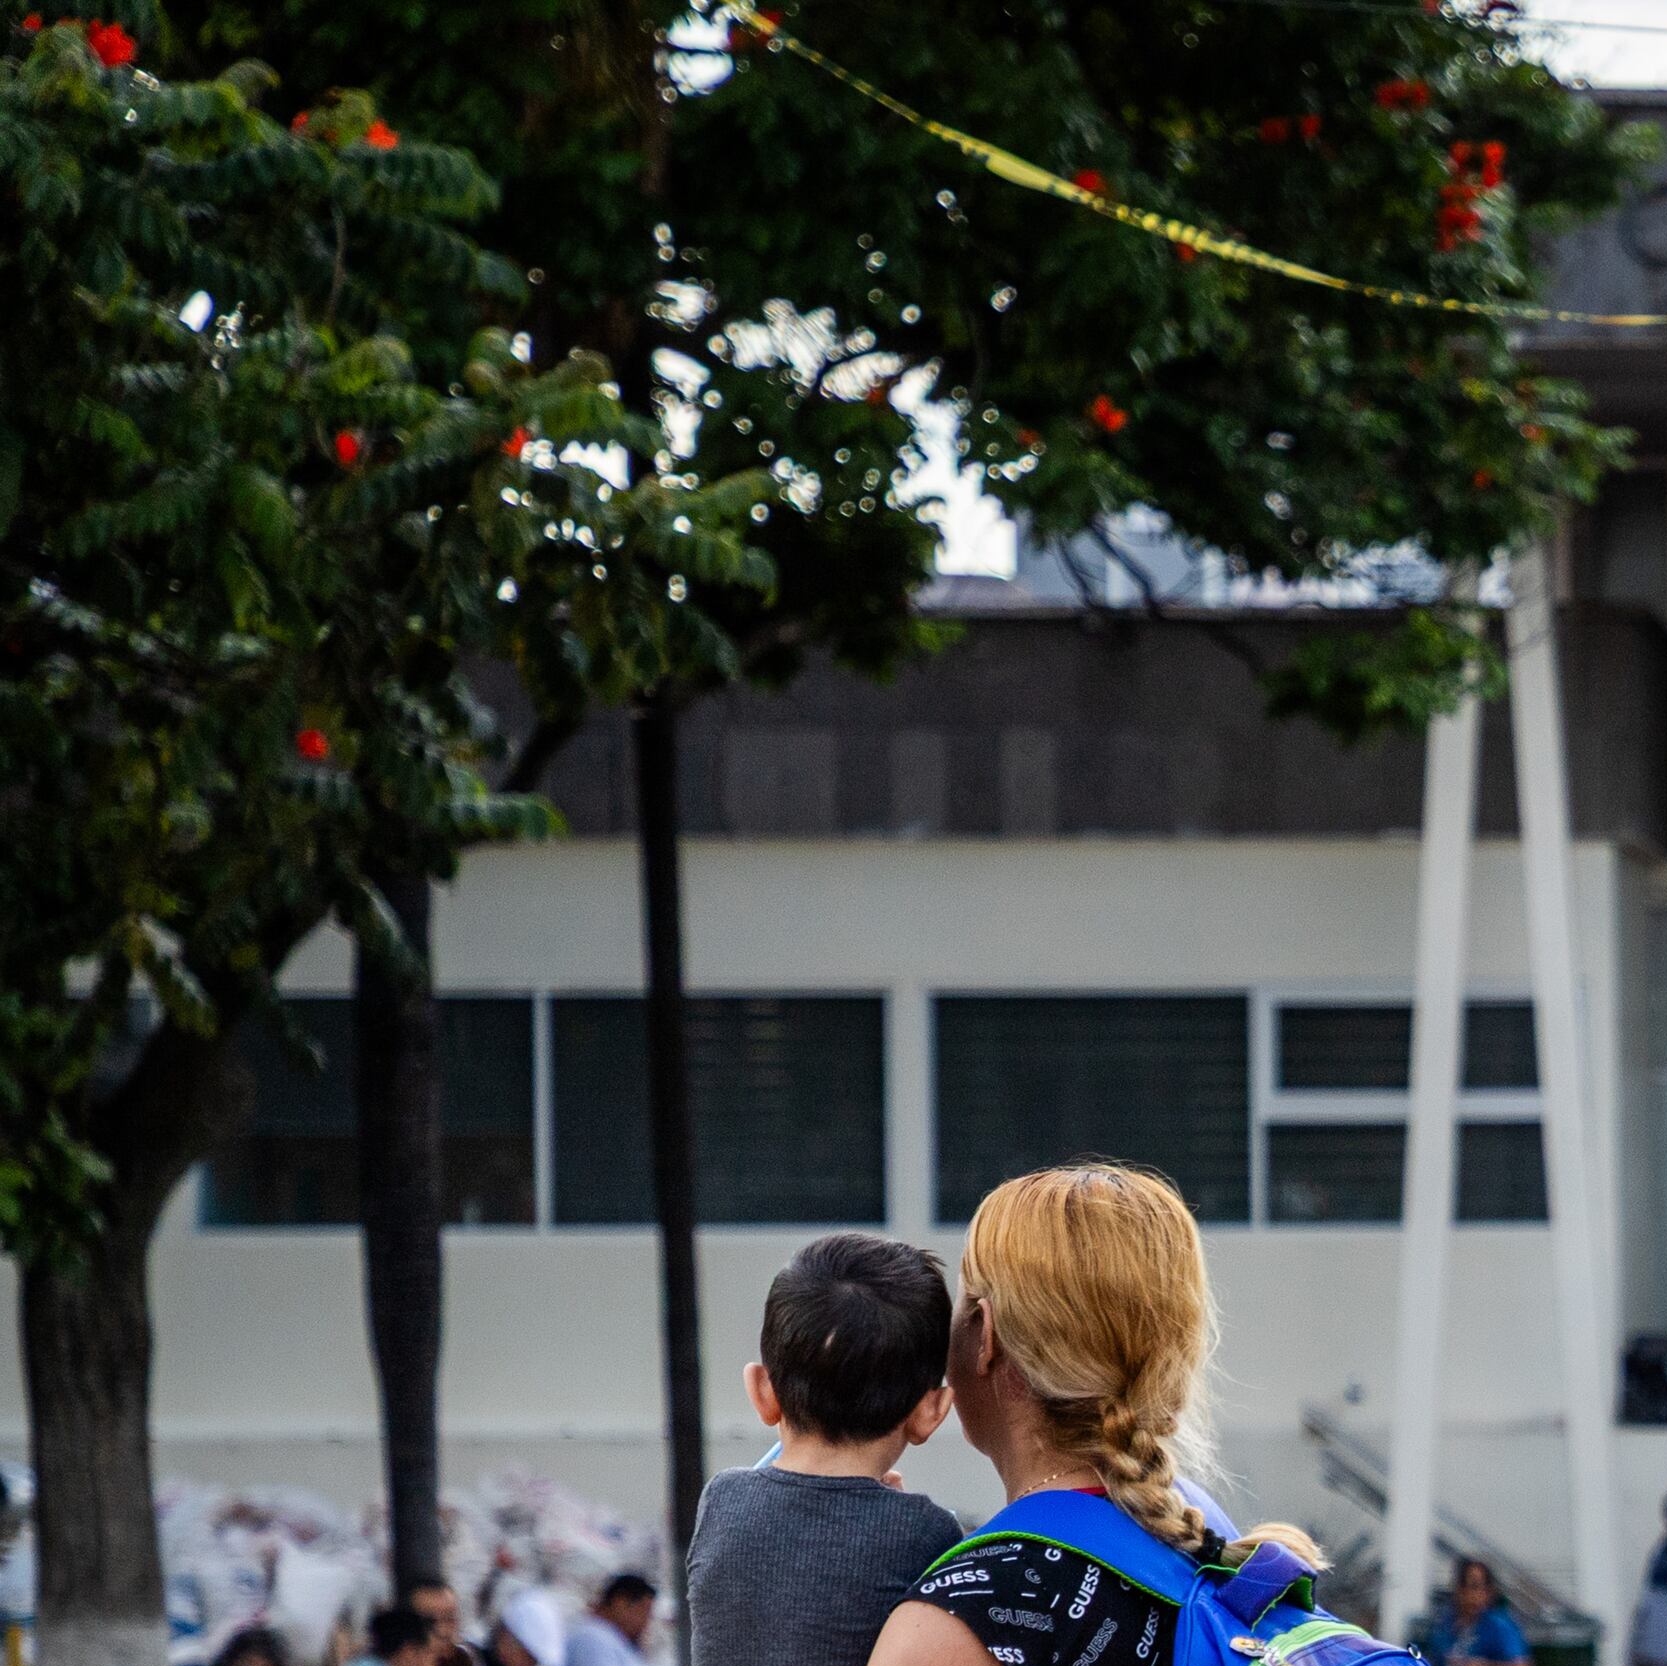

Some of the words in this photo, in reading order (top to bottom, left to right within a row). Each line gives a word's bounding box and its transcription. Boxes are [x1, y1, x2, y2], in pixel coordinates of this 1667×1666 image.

[920, 1570, 990, 1594] GUESS
[1068, 1564, 1100, 1620] GUESS
[988, 1607, 1055, 1633] GUESS
[1136, 1607, 1160, 1659] GUESS
[988, 1647, 1025, 1664] ESS
